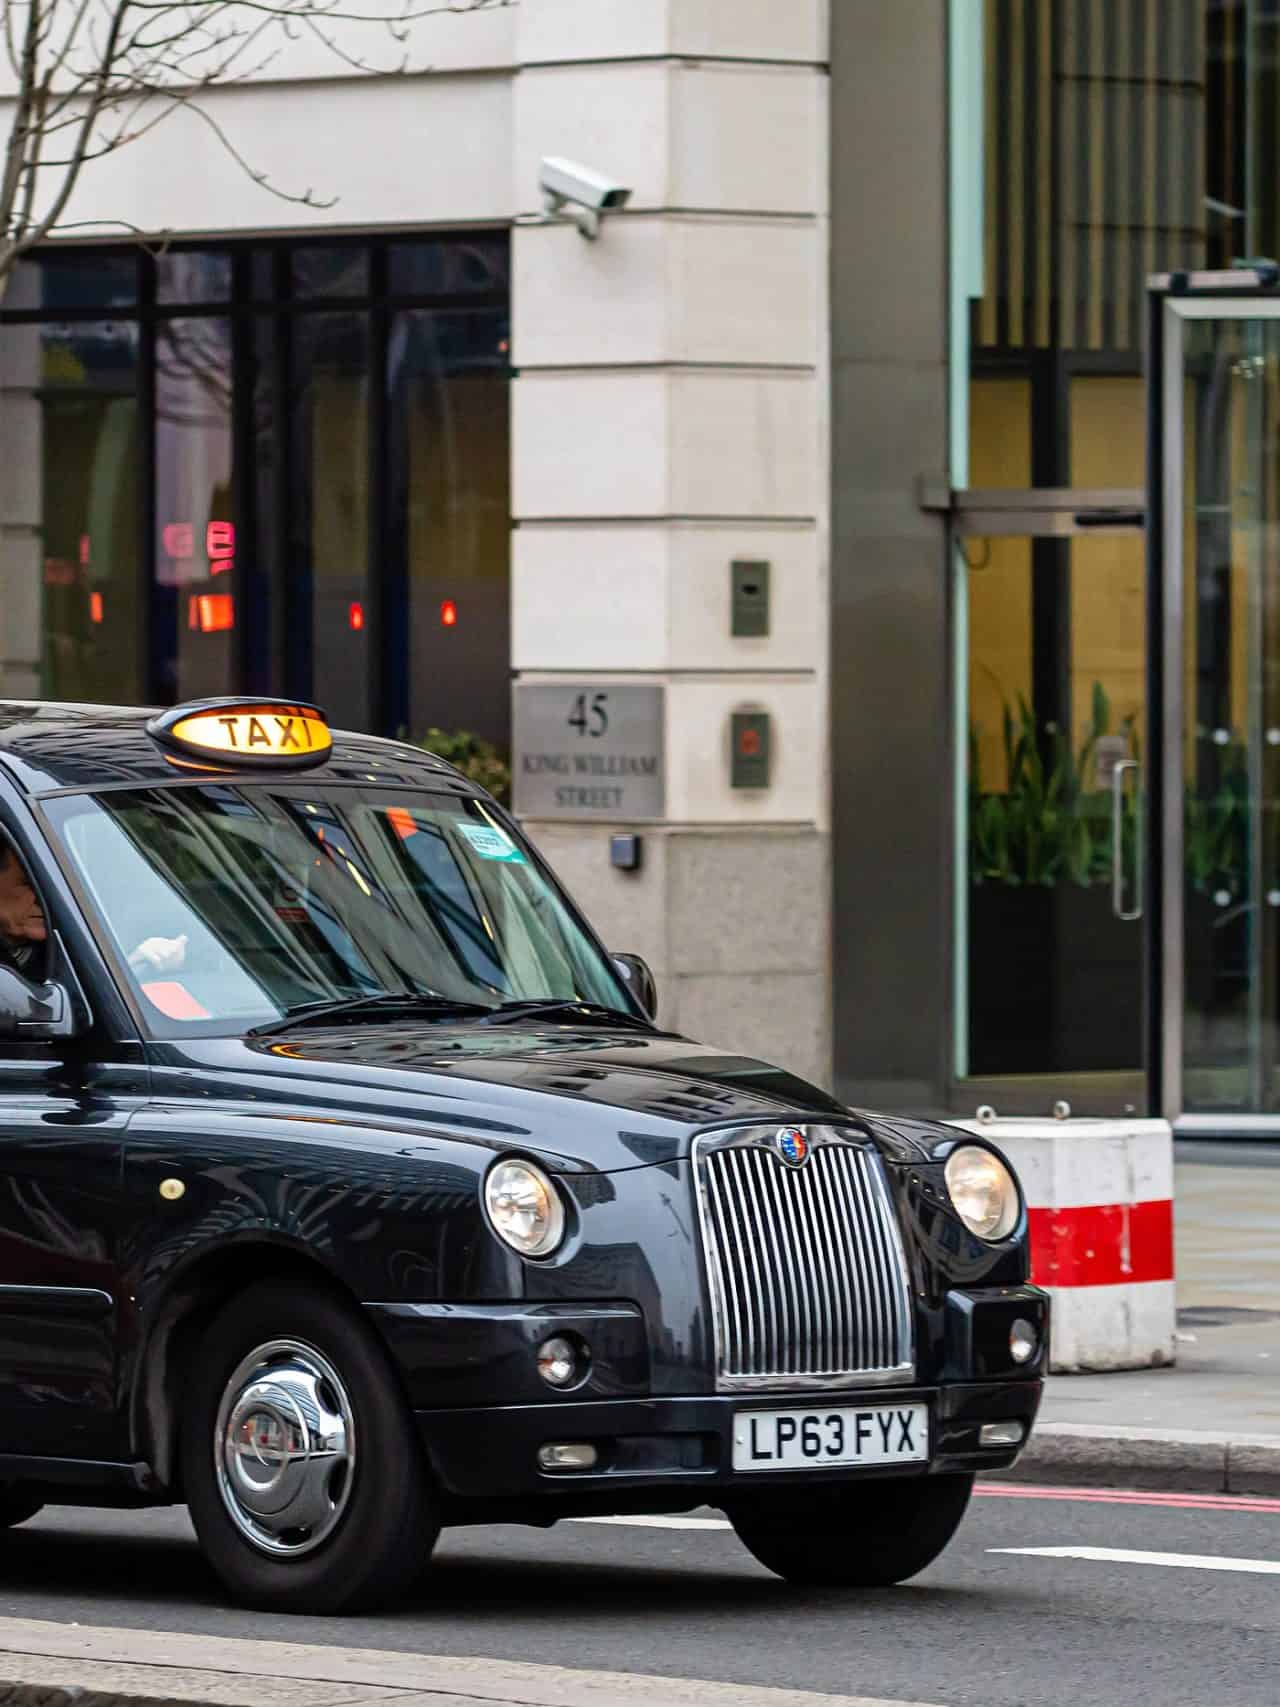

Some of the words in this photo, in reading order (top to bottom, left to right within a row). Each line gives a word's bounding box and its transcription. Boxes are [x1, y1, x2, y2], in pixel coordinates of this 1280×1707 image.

[567, 692, 609, 738] 45
[217, 716, 313, 748] TAXI
[522, 754, 567, 776] KING
[574, 754, 658, 777] WILLIAM
[554, 786, 624, 808] STREET
[750, 1414, 845, 1460] LP63
[855, 1410, 915, 1455] FYX
